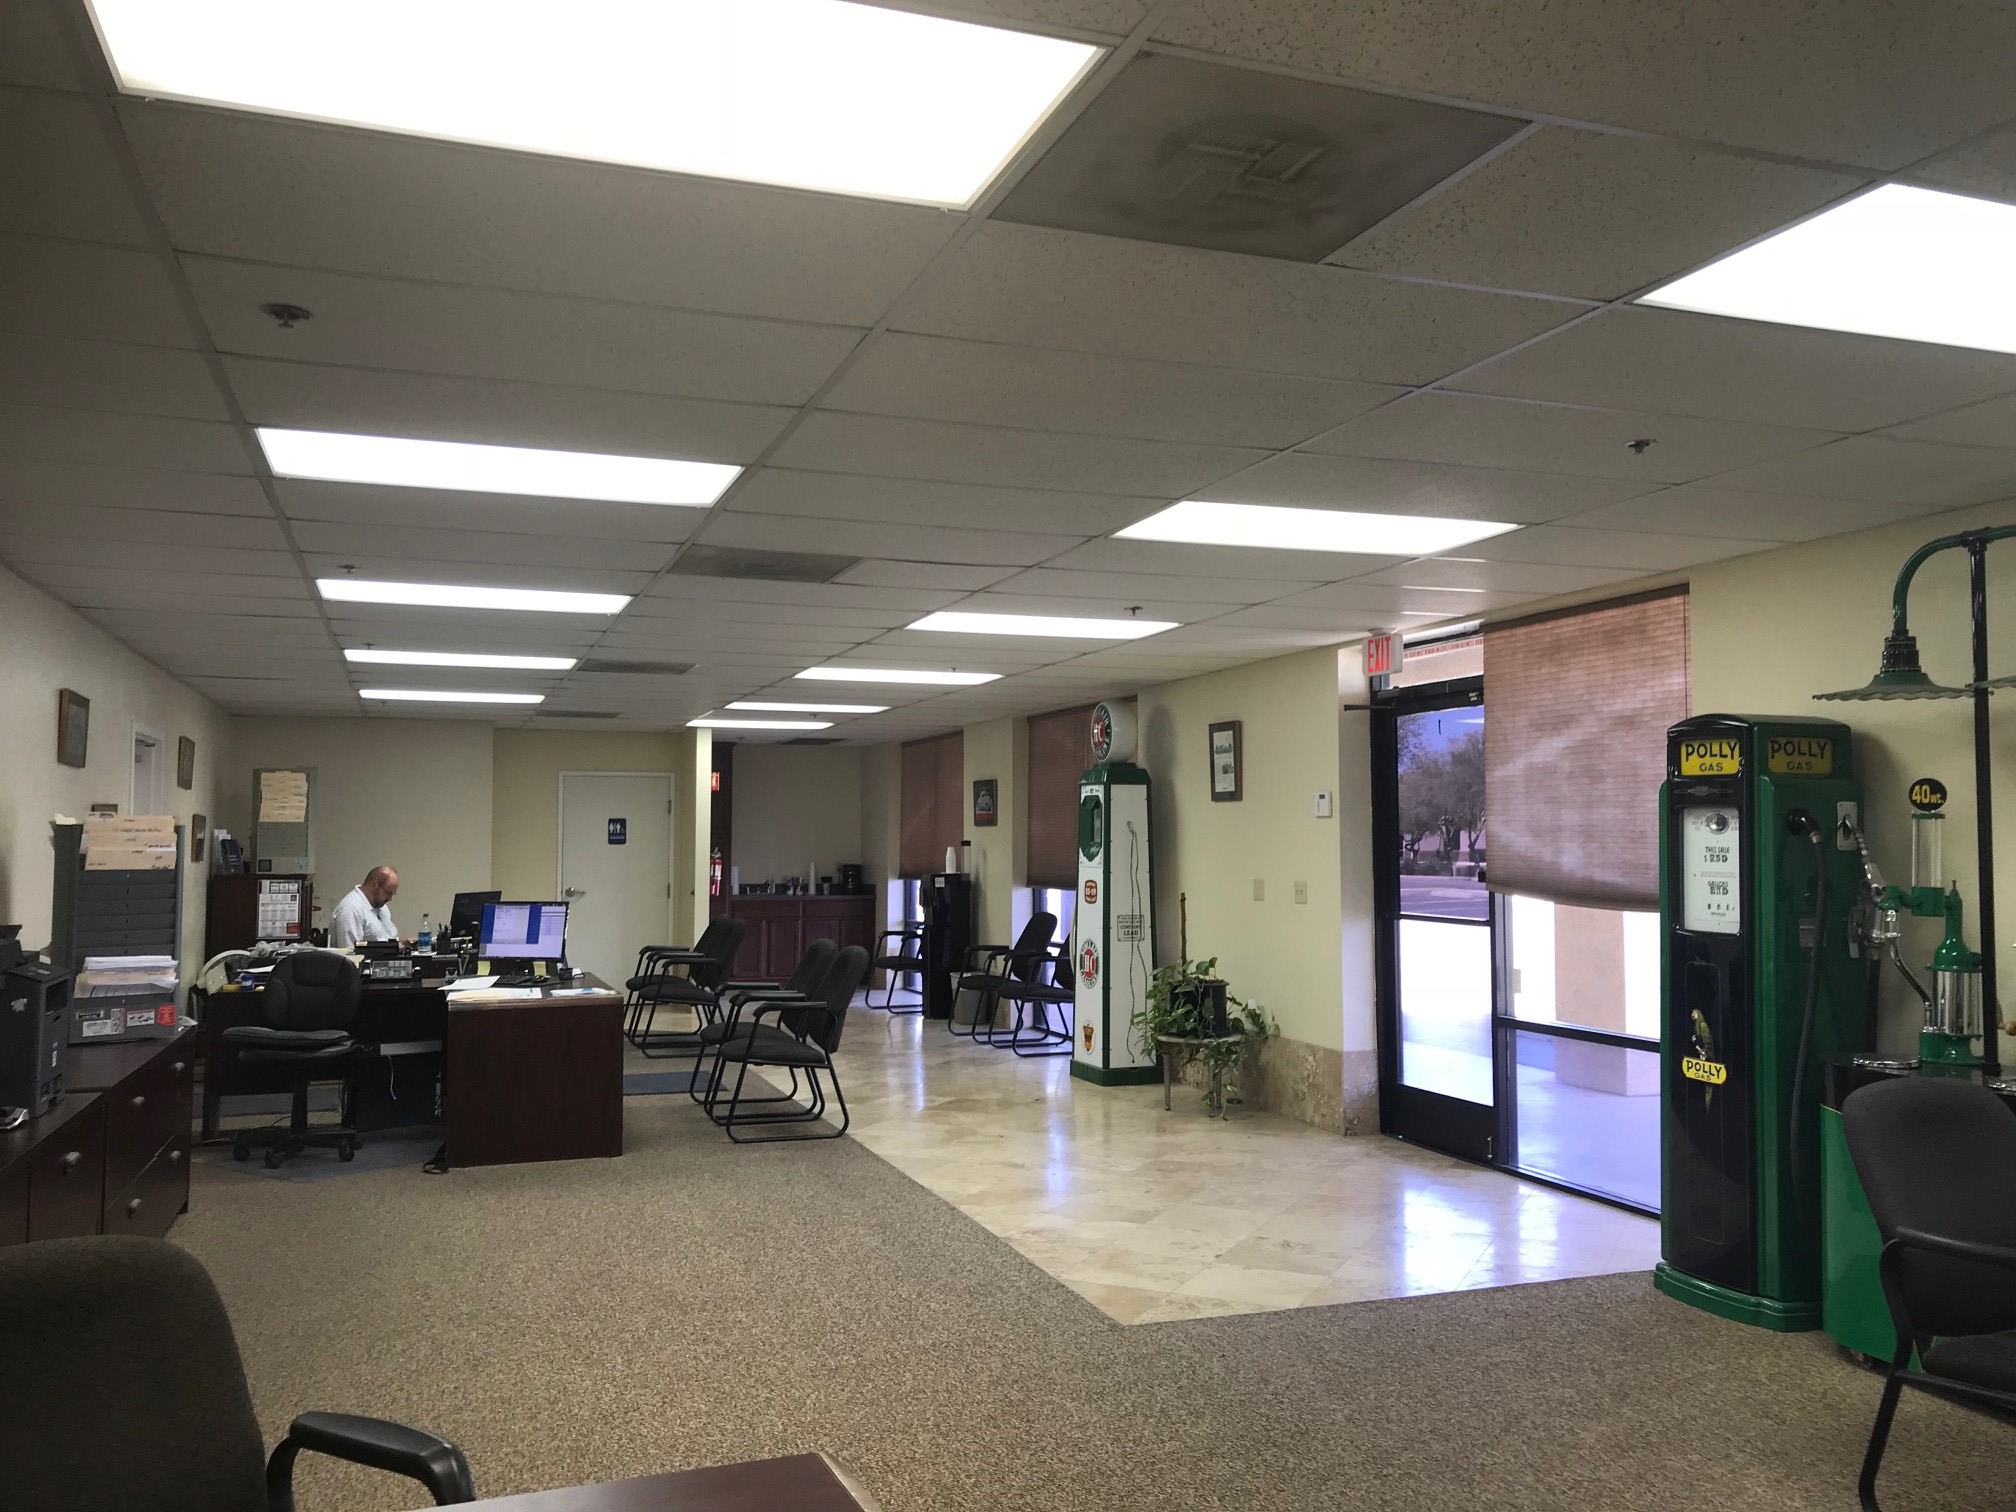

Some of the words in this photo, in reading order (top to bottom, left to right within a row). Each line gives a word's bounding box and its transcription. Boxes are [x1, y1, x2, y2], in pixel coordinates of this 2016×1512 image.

[1368, 636, 1391, 673] EXIT
[1685, 741, 1738, 762] POLLY
[1770, 740, 1827, 760] POLLY
[1700, 763, 1724, 772] GAS
[1786, 761, 1812, 770] GAS
[1686, 1060, 1722, 1080] POLLY
[1694, 1072, 1712, 1081] GAS
